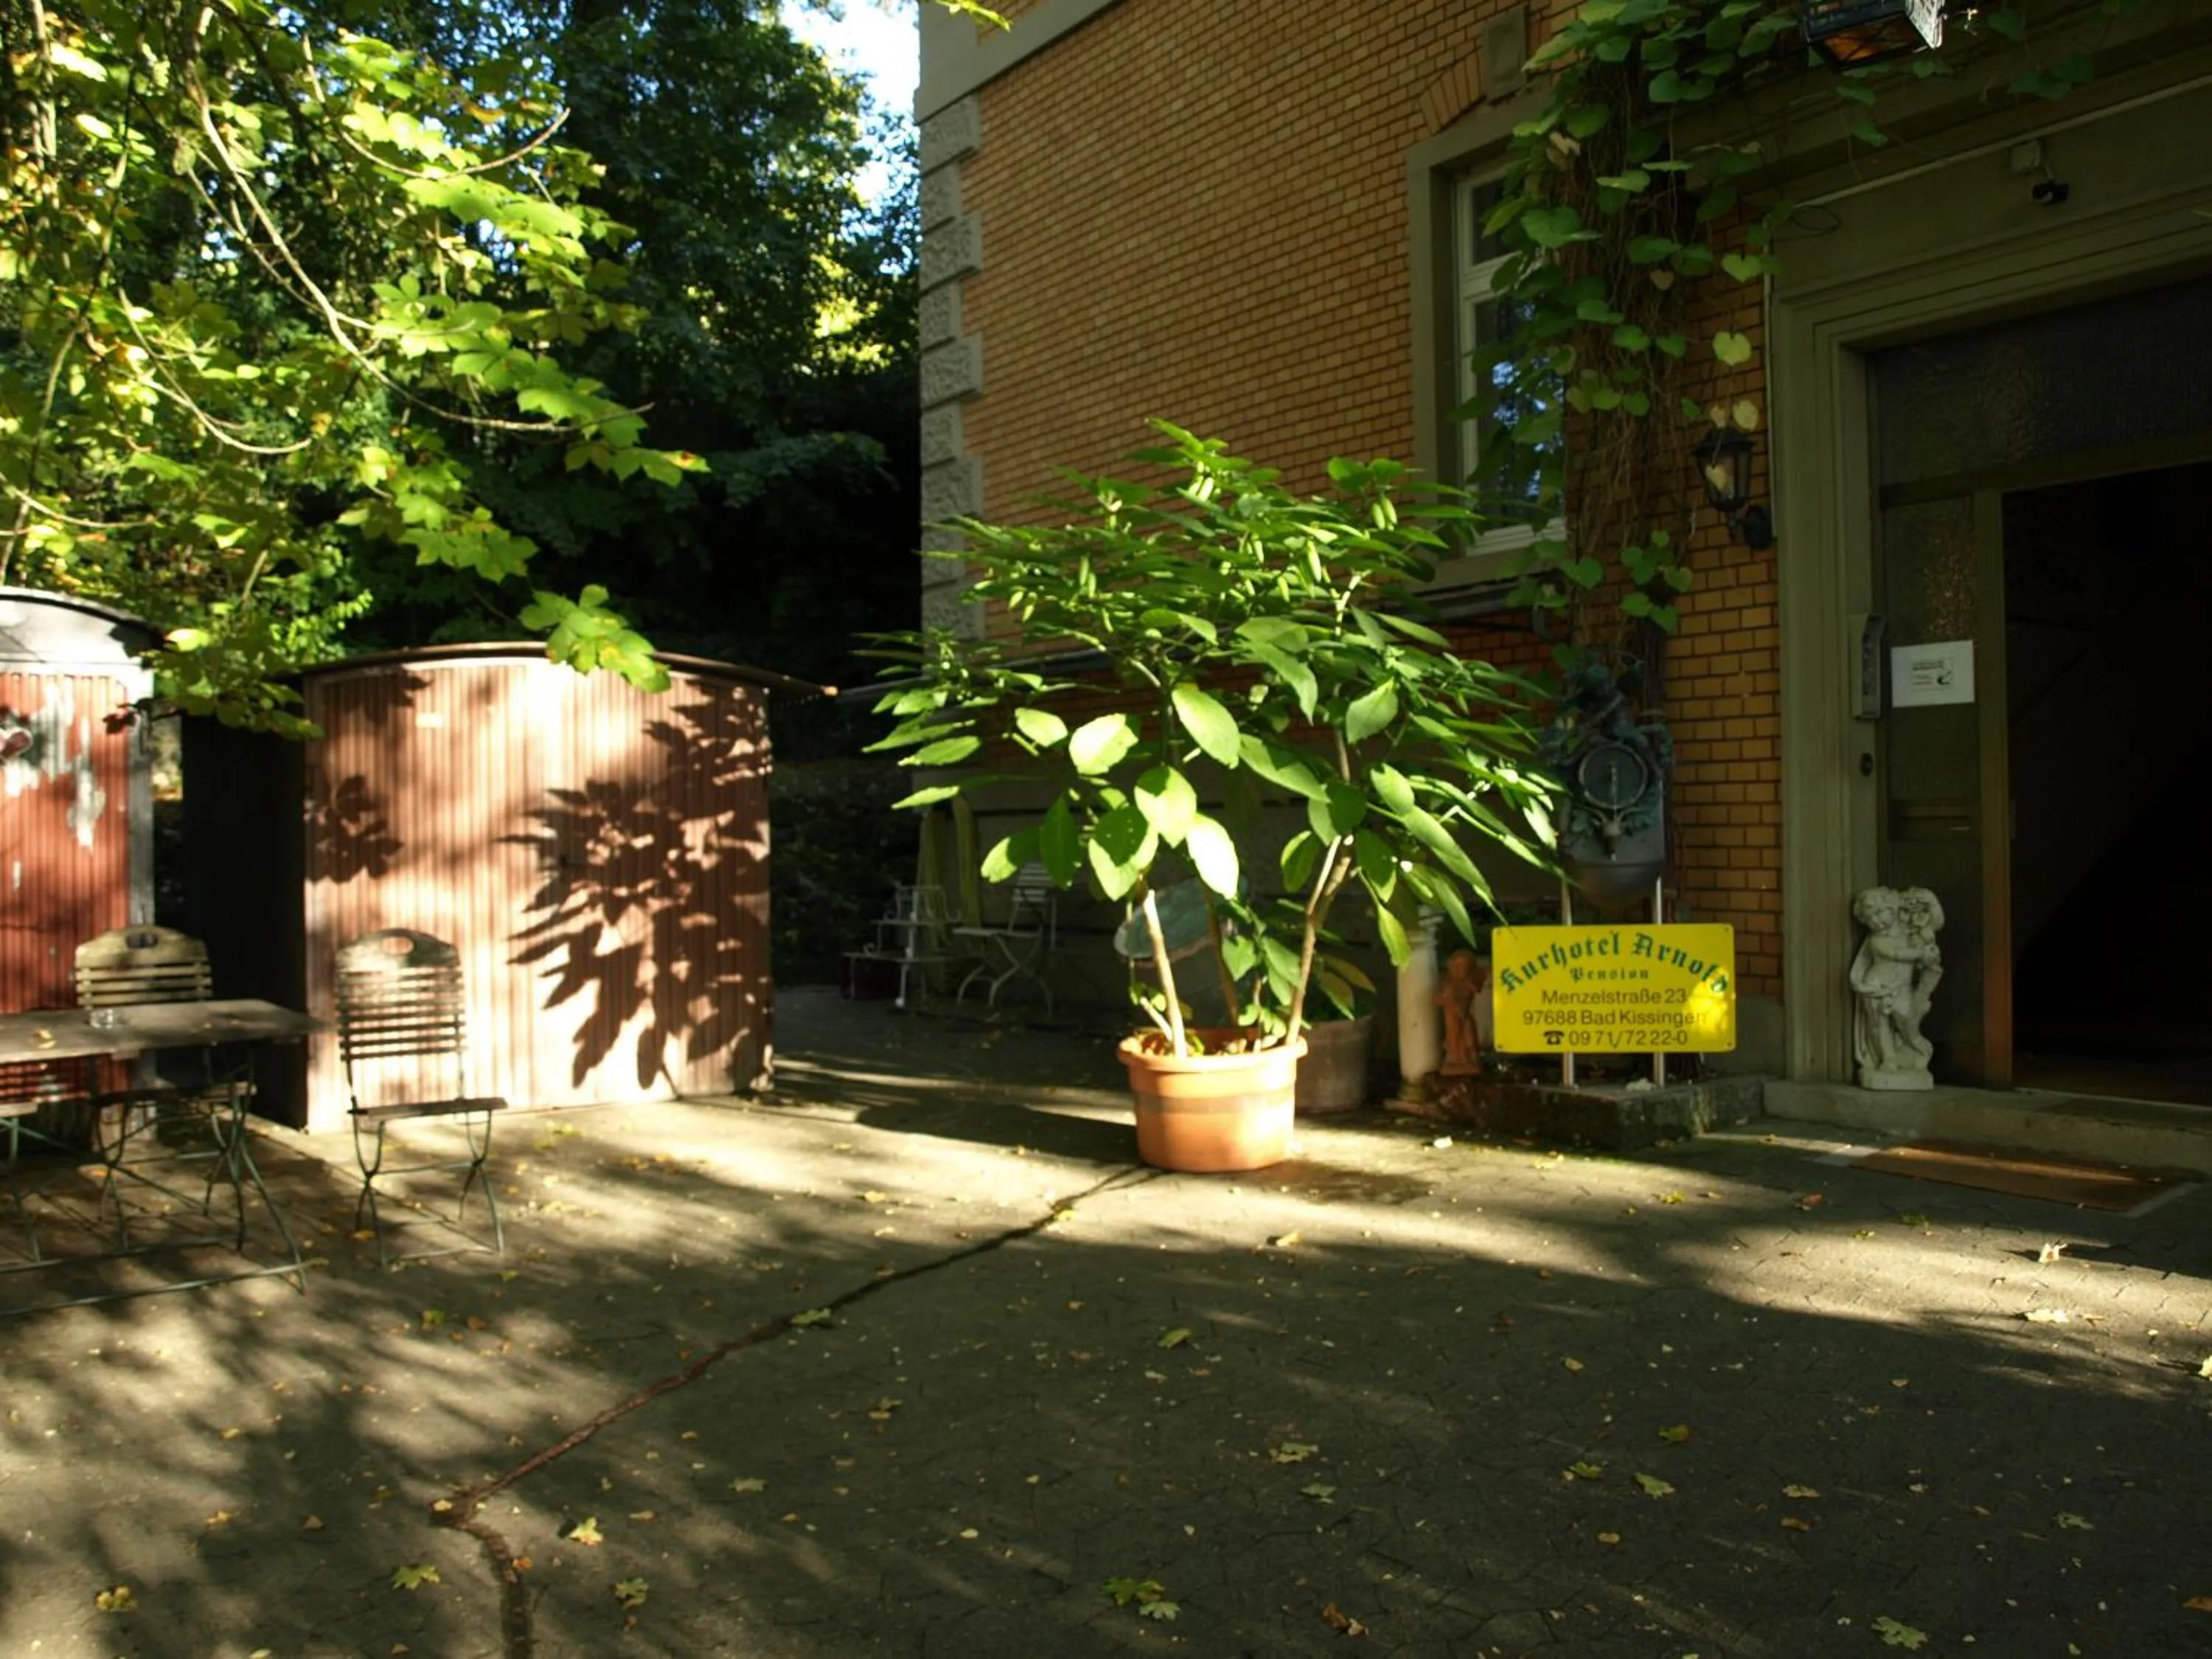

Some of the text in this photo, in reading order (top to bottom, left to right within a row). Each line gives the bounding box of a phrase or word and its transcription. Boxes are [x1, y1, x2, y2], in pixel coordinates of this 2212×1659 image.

[1500, 931, 1619, 992] Kurhotel
[1570, 967, 1649, 982] Pension
[1543, 989, 1686, 1004] Menzelstraße 23
[1523, 1009, 1577, 1026] 97688
[1581, 1009, 1615, 1025] Bad
